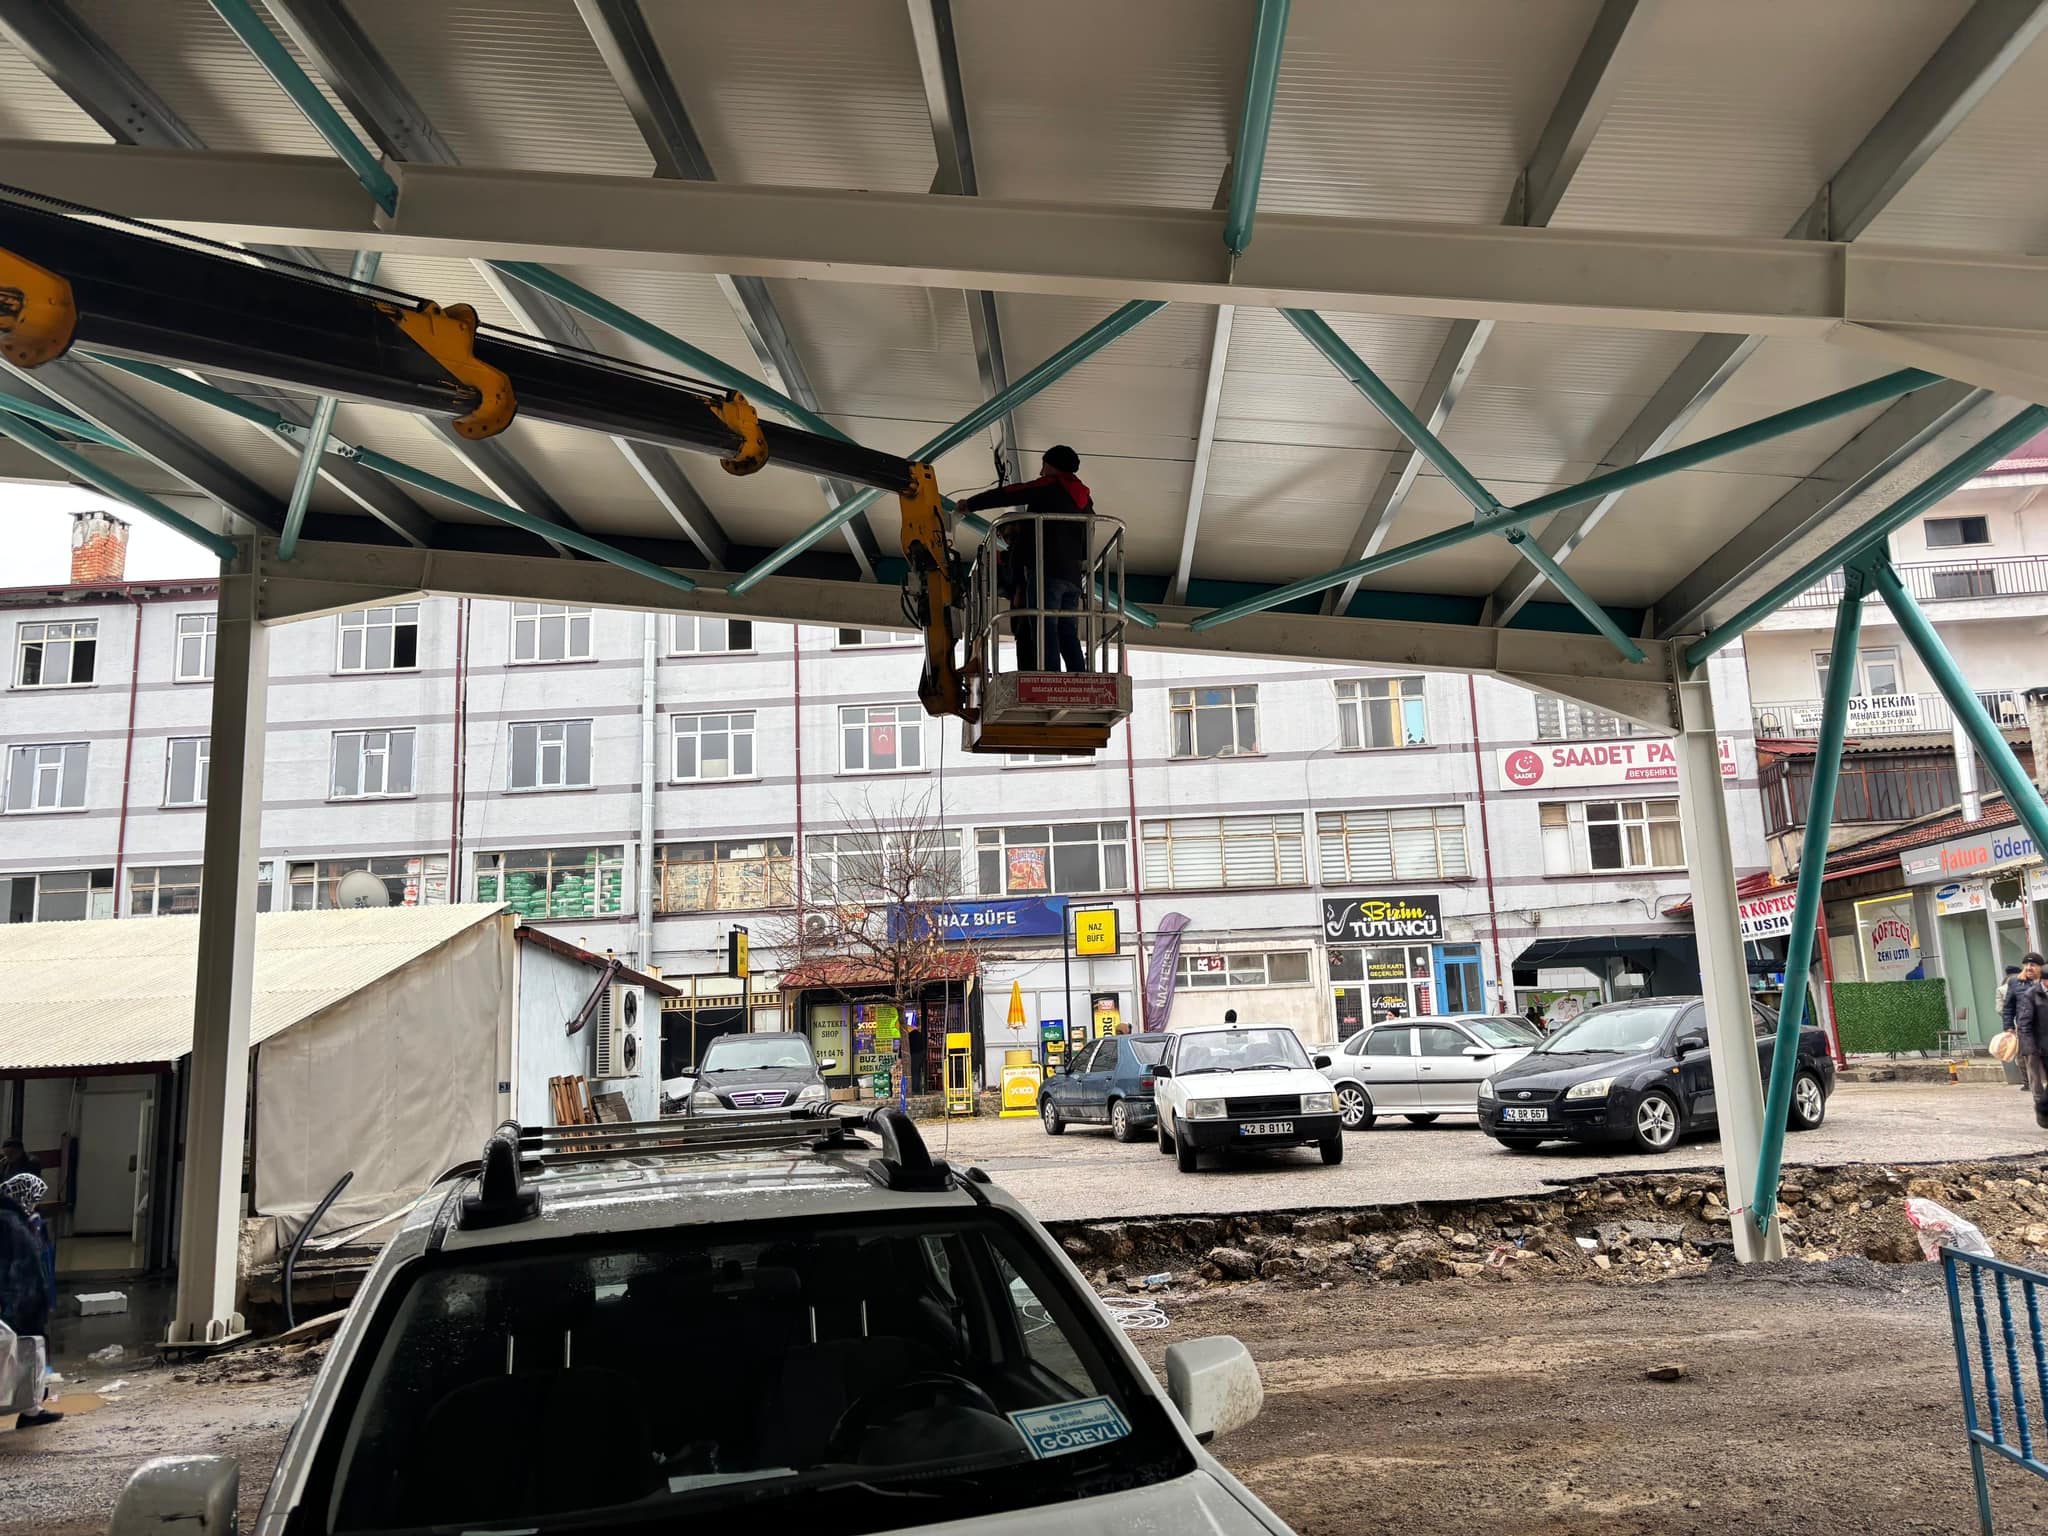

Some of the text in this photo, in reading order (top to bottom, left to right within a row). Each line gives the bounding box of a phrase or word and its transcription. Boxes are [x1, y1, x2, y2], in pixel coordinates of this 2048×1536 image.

[1850, 712, 1880, 720] MEHMET
[1552, 745, 1635, 768] SAADET
[1629, 768, 1667, 778] BEYŞEHİR
[1941, 846, 1989, 873] Fatura
[1994, 837, 2038, 860] ödem
[937, 909, 1017, 928] NAZ BÜFE
[1088, 922, 1103, 931] NAZ
[1349, 914, 1438, 938] TÜTÜNCÜ
[1753, 915, 1789, 932] USTA
[1086, 932, 1105, 943] BÜFE
[1871, 919, 1912, 950] KÖFTECİ
[1877, 947, 1910, 962] ZEKİ USTA
[821, 1030, 839, 1039] SHOP
[859, 1055, 877, 1063] BUZ
[1040, 1420, 1122, 1451] GÖREVLİ
